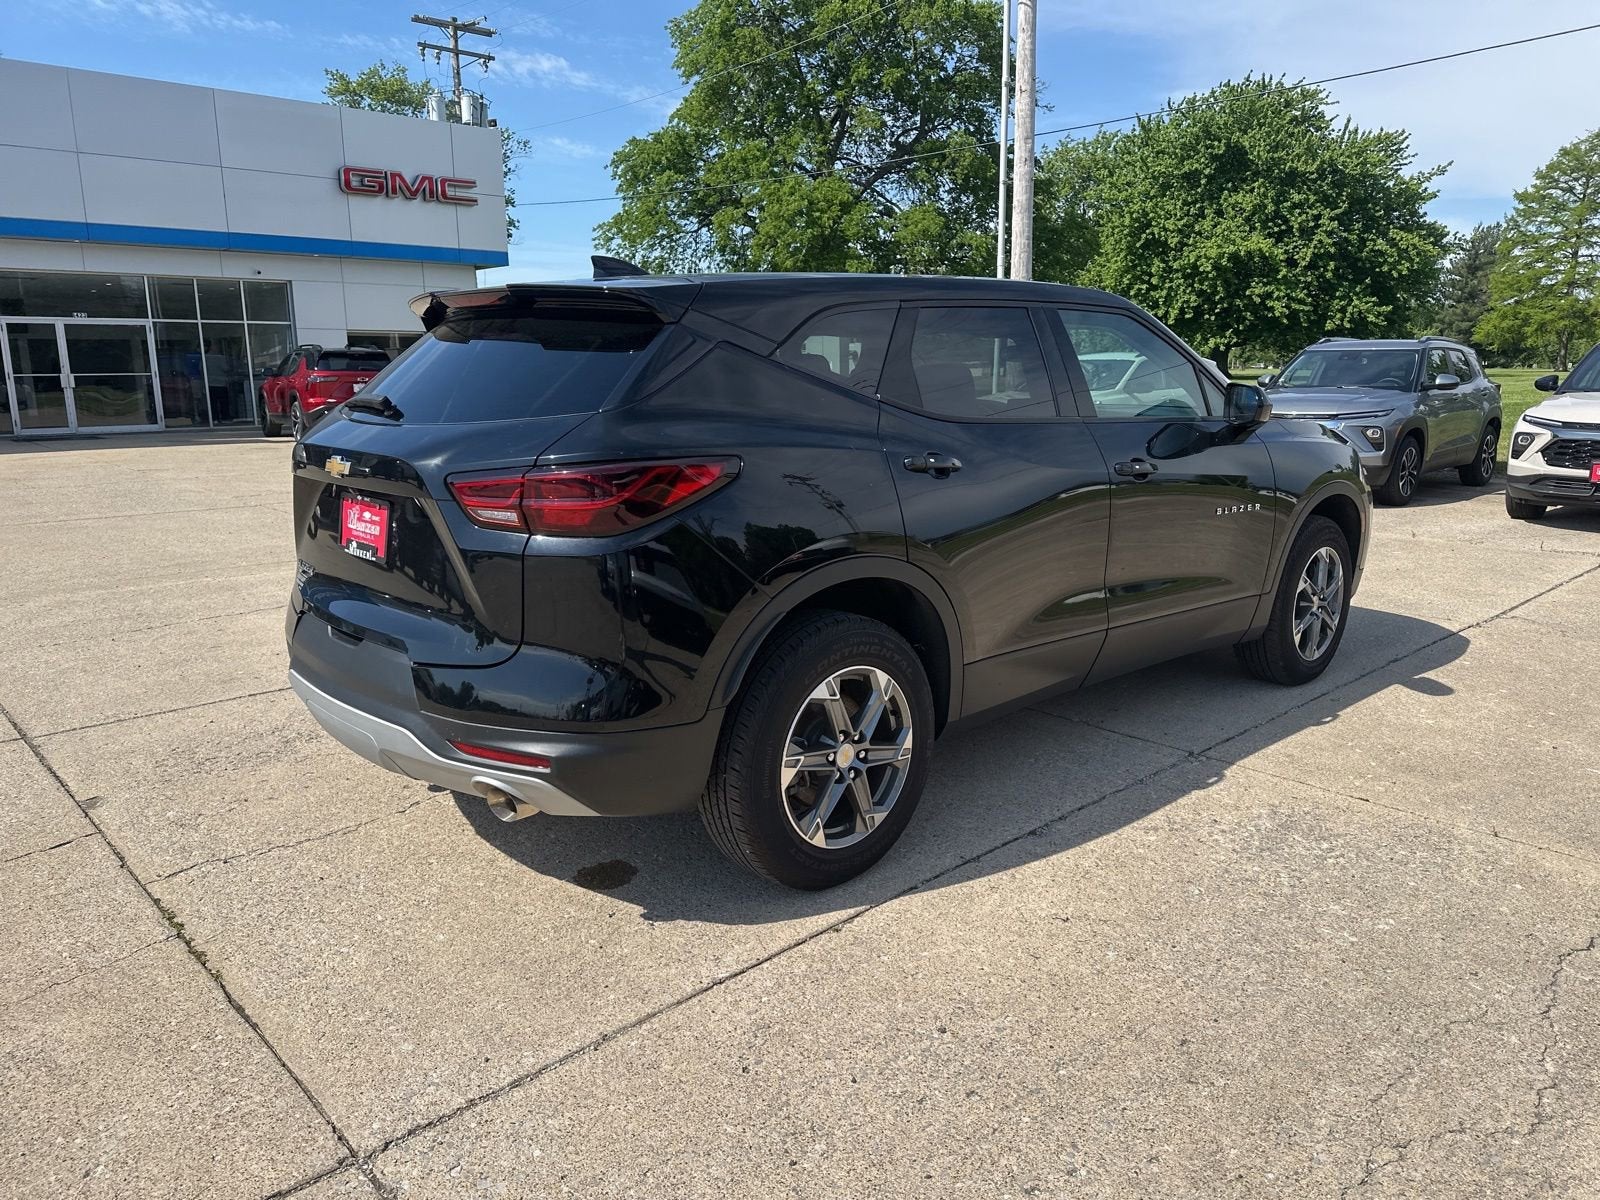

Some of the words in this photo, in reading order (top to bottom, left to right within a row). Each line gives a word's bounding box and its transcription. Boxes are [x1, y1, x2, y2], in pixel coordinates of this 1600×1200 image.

[338, 165, 478, 206] GMC
[1216, 503, 1261, 515] BLAZER
[804, 644, 913, 685] CONTINENTAL
